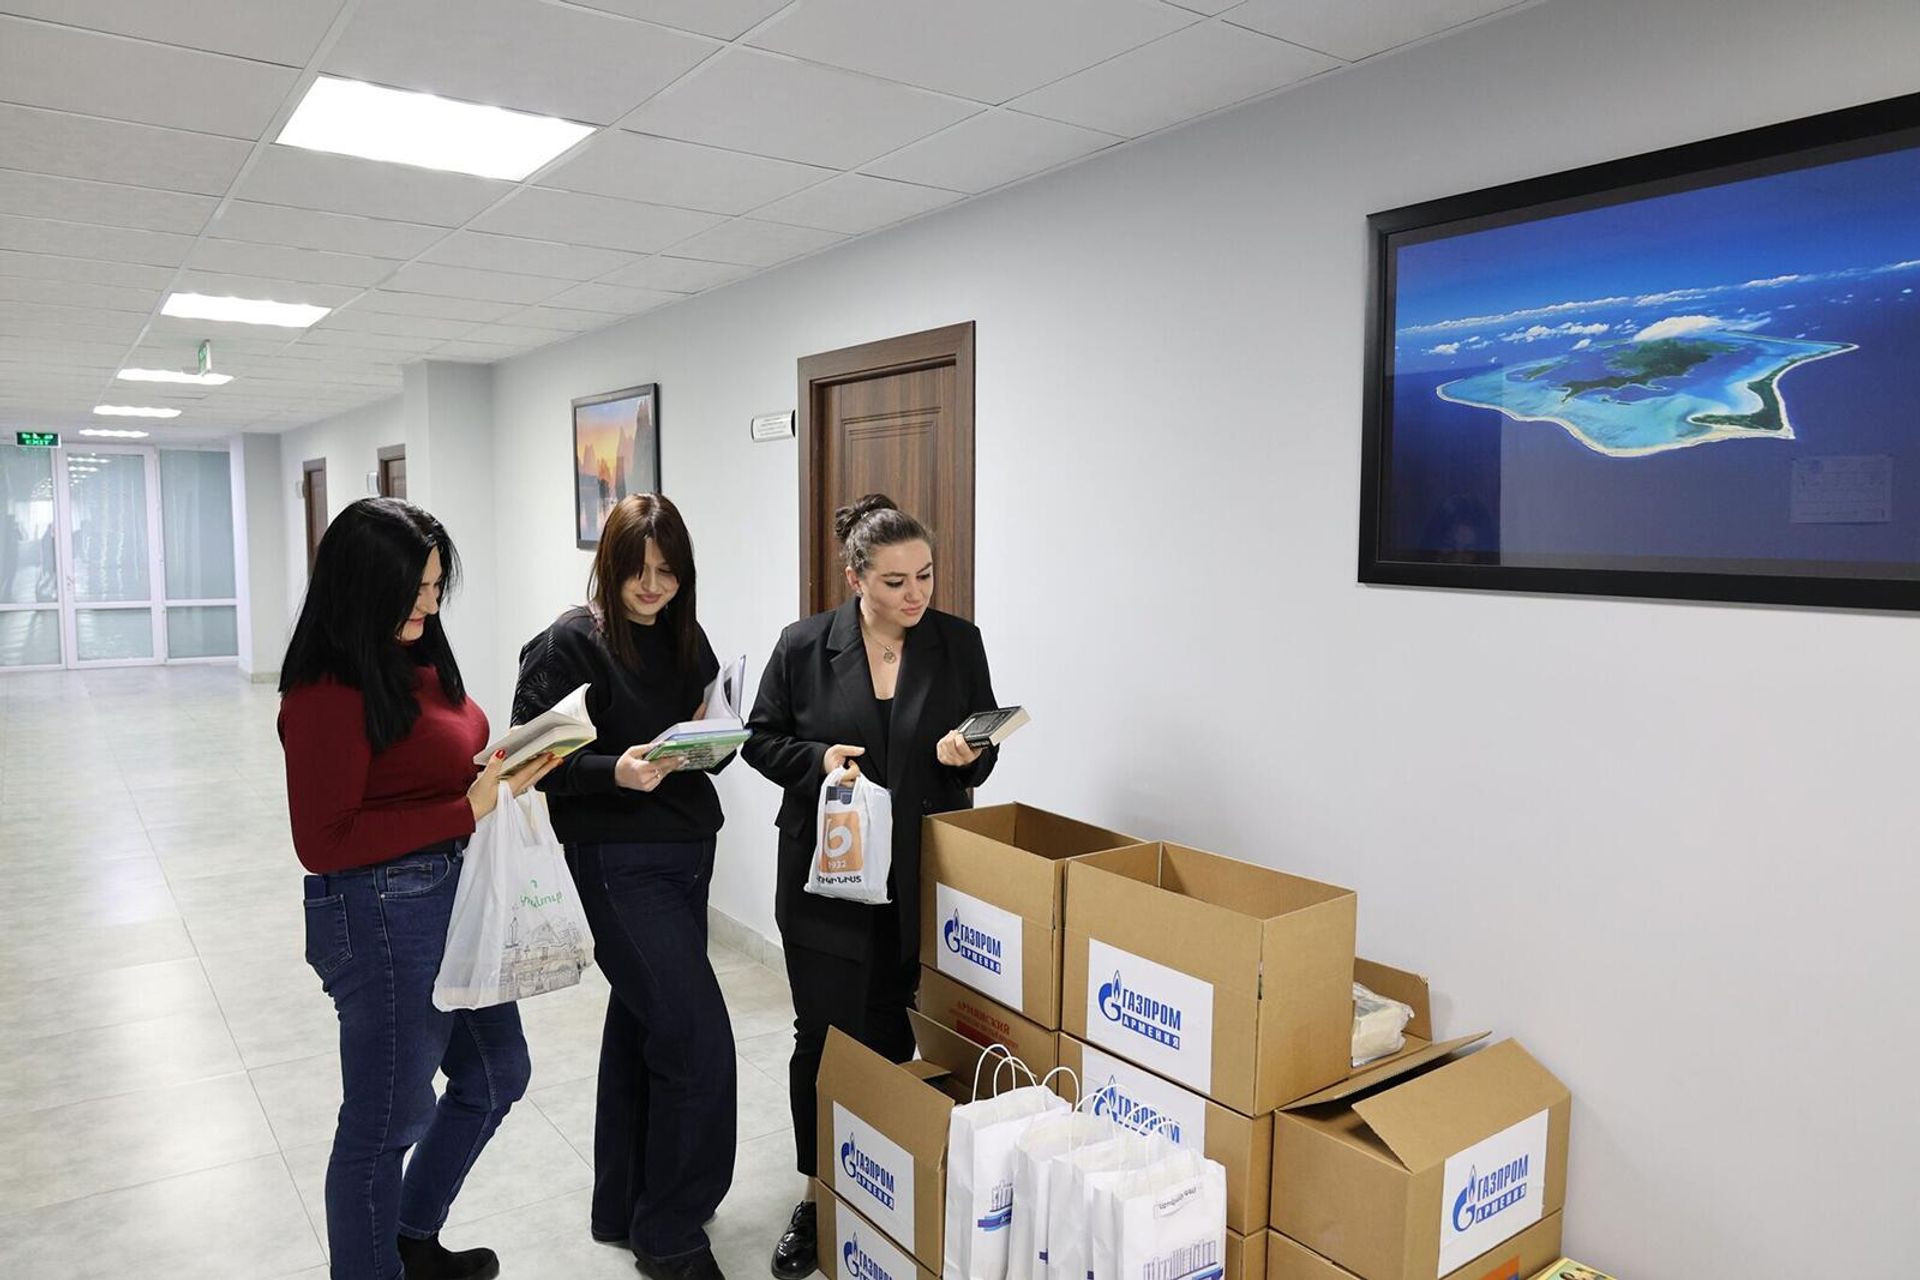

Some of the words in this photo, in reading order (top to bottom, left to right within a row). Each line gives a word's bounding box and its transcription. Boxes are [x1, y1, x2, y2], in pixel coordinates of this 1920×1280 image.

[960, 923, 1001, 959] ГАЗПРОМ
[961, 944, 1001, 974] АРМЕНИЯ
[1122, 988, 1181, 1032] ГАЗПРОМ
[1122, 1014, 1180, 1050] АРМЕНИЯ
[857, 1149, 894, 1194] ГАЗПРОМ
[1477, 1154, 1528, 1202] ГАЗПРОМ
[1476, 1183, 1527, 1223] АРМЕНИЯ
